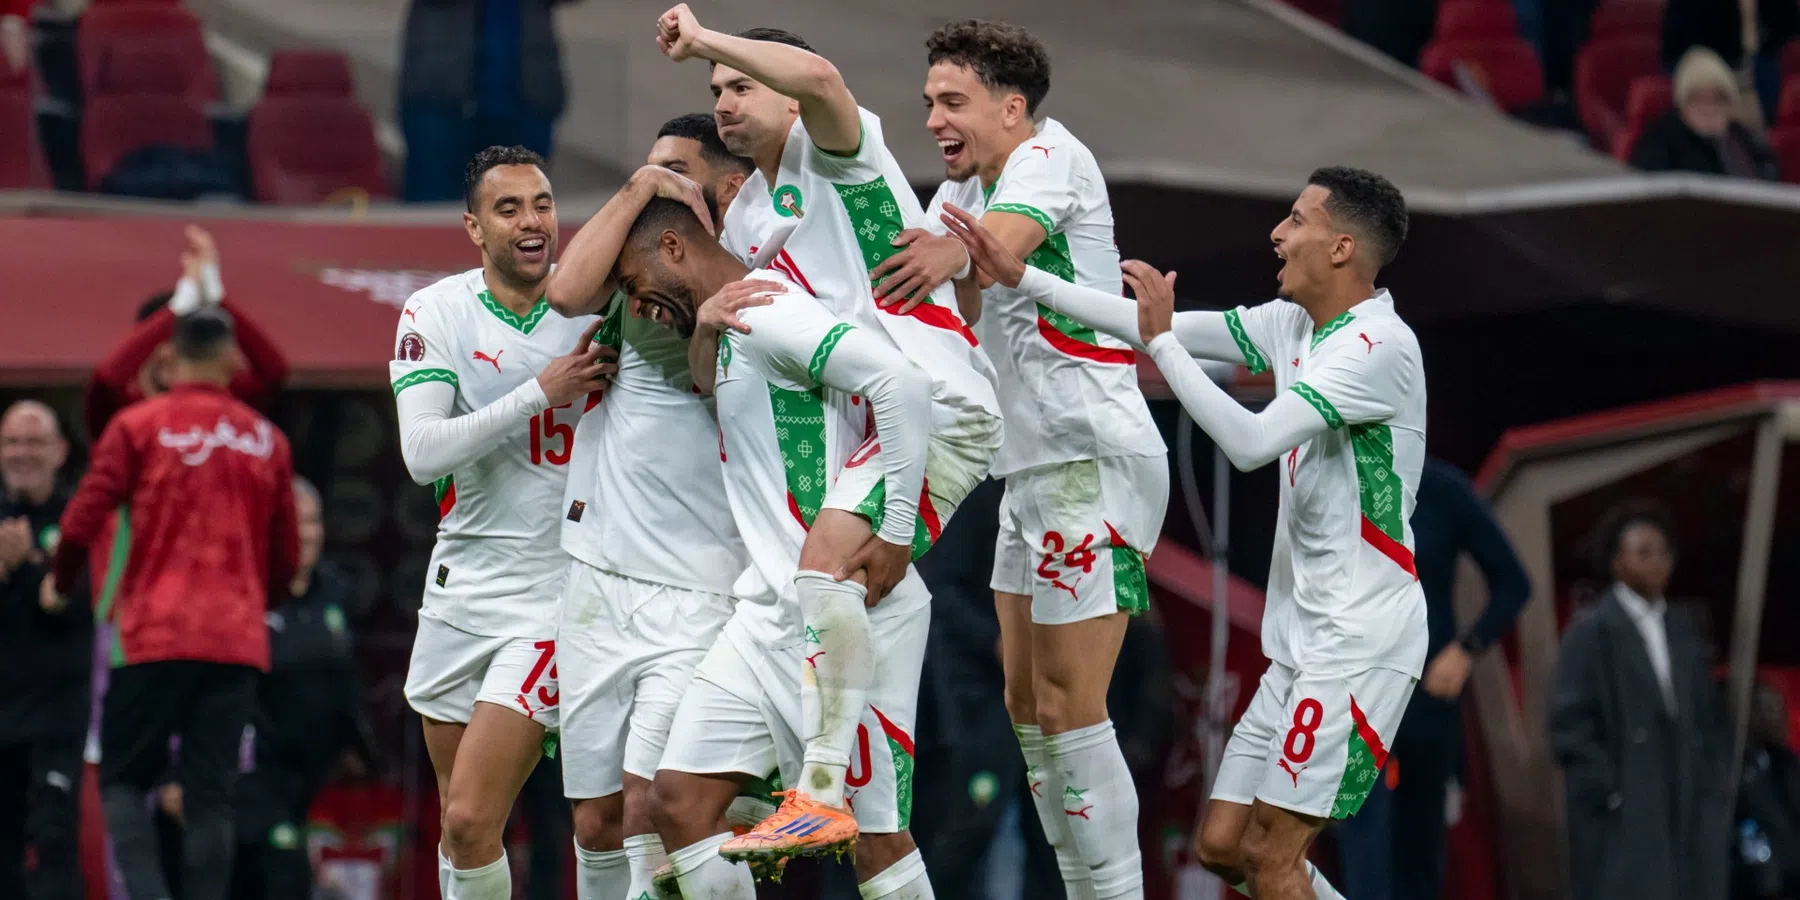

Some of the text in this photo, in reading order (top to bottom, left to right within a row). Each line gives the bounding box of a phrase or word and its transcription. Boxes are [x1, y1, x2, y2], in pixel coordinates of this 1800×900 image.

[157, 416, 274, 466] المغرب
[529, 401, 574, 466] 15
[1037, 531, 1096, 579] 24
[1283, 697, 1324, 764] 8
